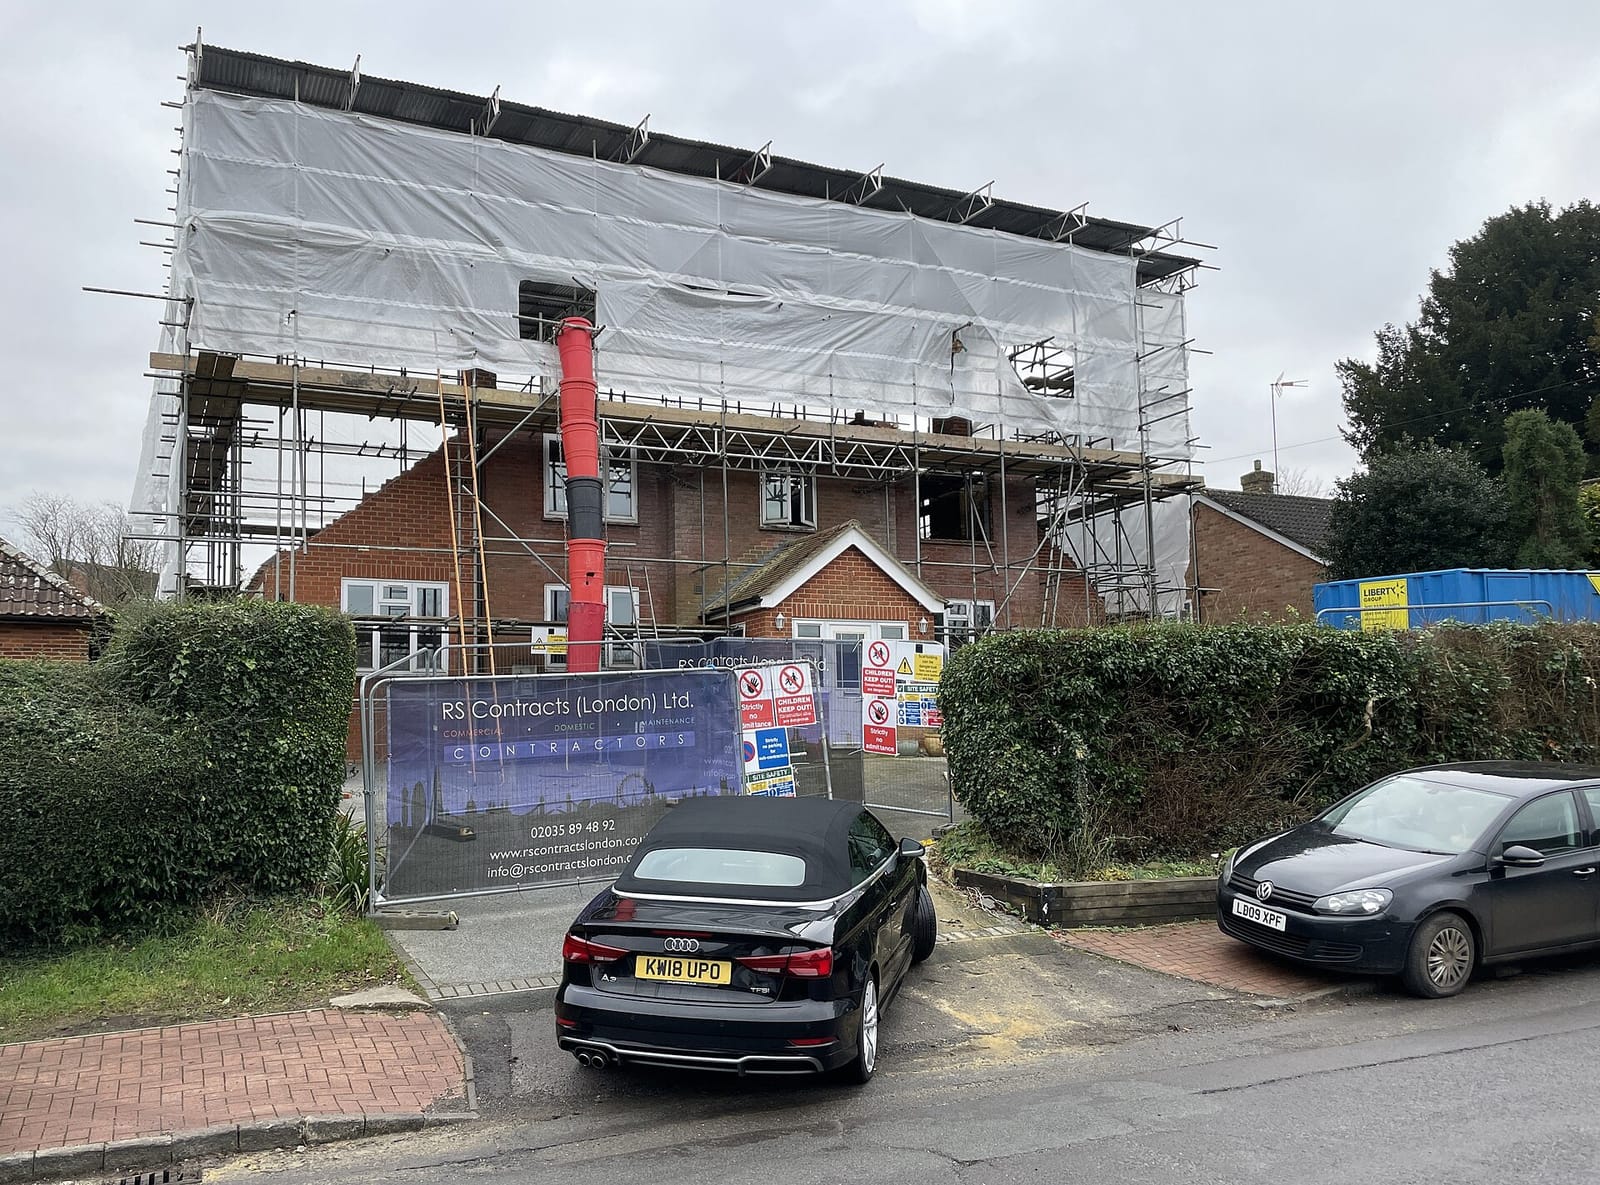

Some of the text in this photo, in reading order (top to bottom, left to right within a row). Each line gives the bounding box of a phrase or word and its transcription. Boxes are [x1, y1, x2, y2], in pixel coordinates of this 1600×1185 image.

[1363, 586, 1396, 597] LIBERTY
[442, 691, 694, 720] RS Contracts (London) Ltd.
[778, 696, 811, 706] CHILDREN
[741, 703, 764, 711] Strictly
[778, 703, 813, 714] KEEP OUT!
[443, 716, 695, 738] COMMERCIAL DOMESTIC MAINTENANCE
[870, 728, 888, 736] Strictly
[453, 733, 684, 759] CONTRACTORS
[865, 743, 895, 752] admittance
[752, 772, 767, 781] SITE
[767, 769, 788, 778] SAFETY
[530, 819, 616, 839] 02035 89 48 92
[1262, 910, 1283, 927] XPF
[645, 958, 721, 980] KW18 UPO
[601, 973, 617, 982] A3
